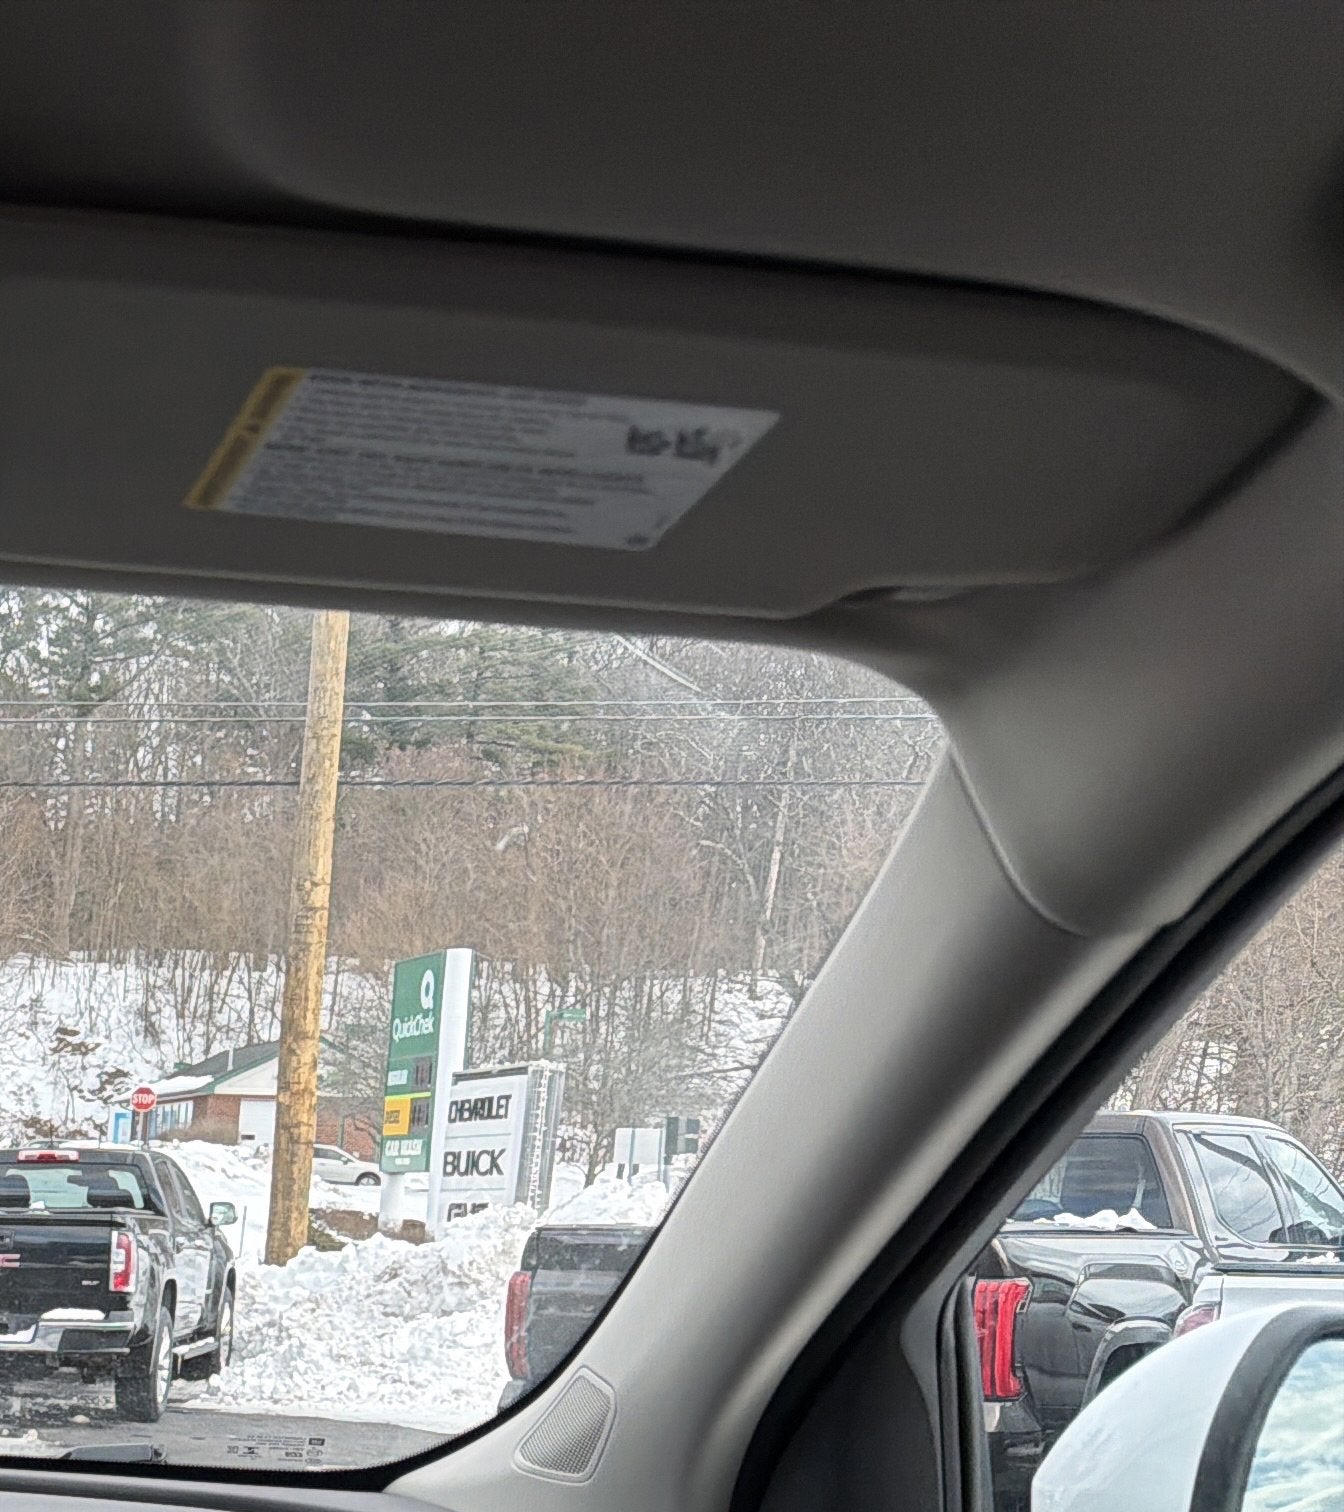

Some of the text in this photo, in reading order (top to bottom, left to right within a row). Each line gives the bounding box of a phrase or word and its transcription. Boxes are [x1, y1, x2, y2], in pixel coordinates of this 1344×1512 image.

[392, 1012, 434, 1042] QuickChek
[132, 1093, 155, 1105] STOP
[448, 1094, 513, 1123] CHEVROLET
[443, 1148, 506, 1177] BUICK
